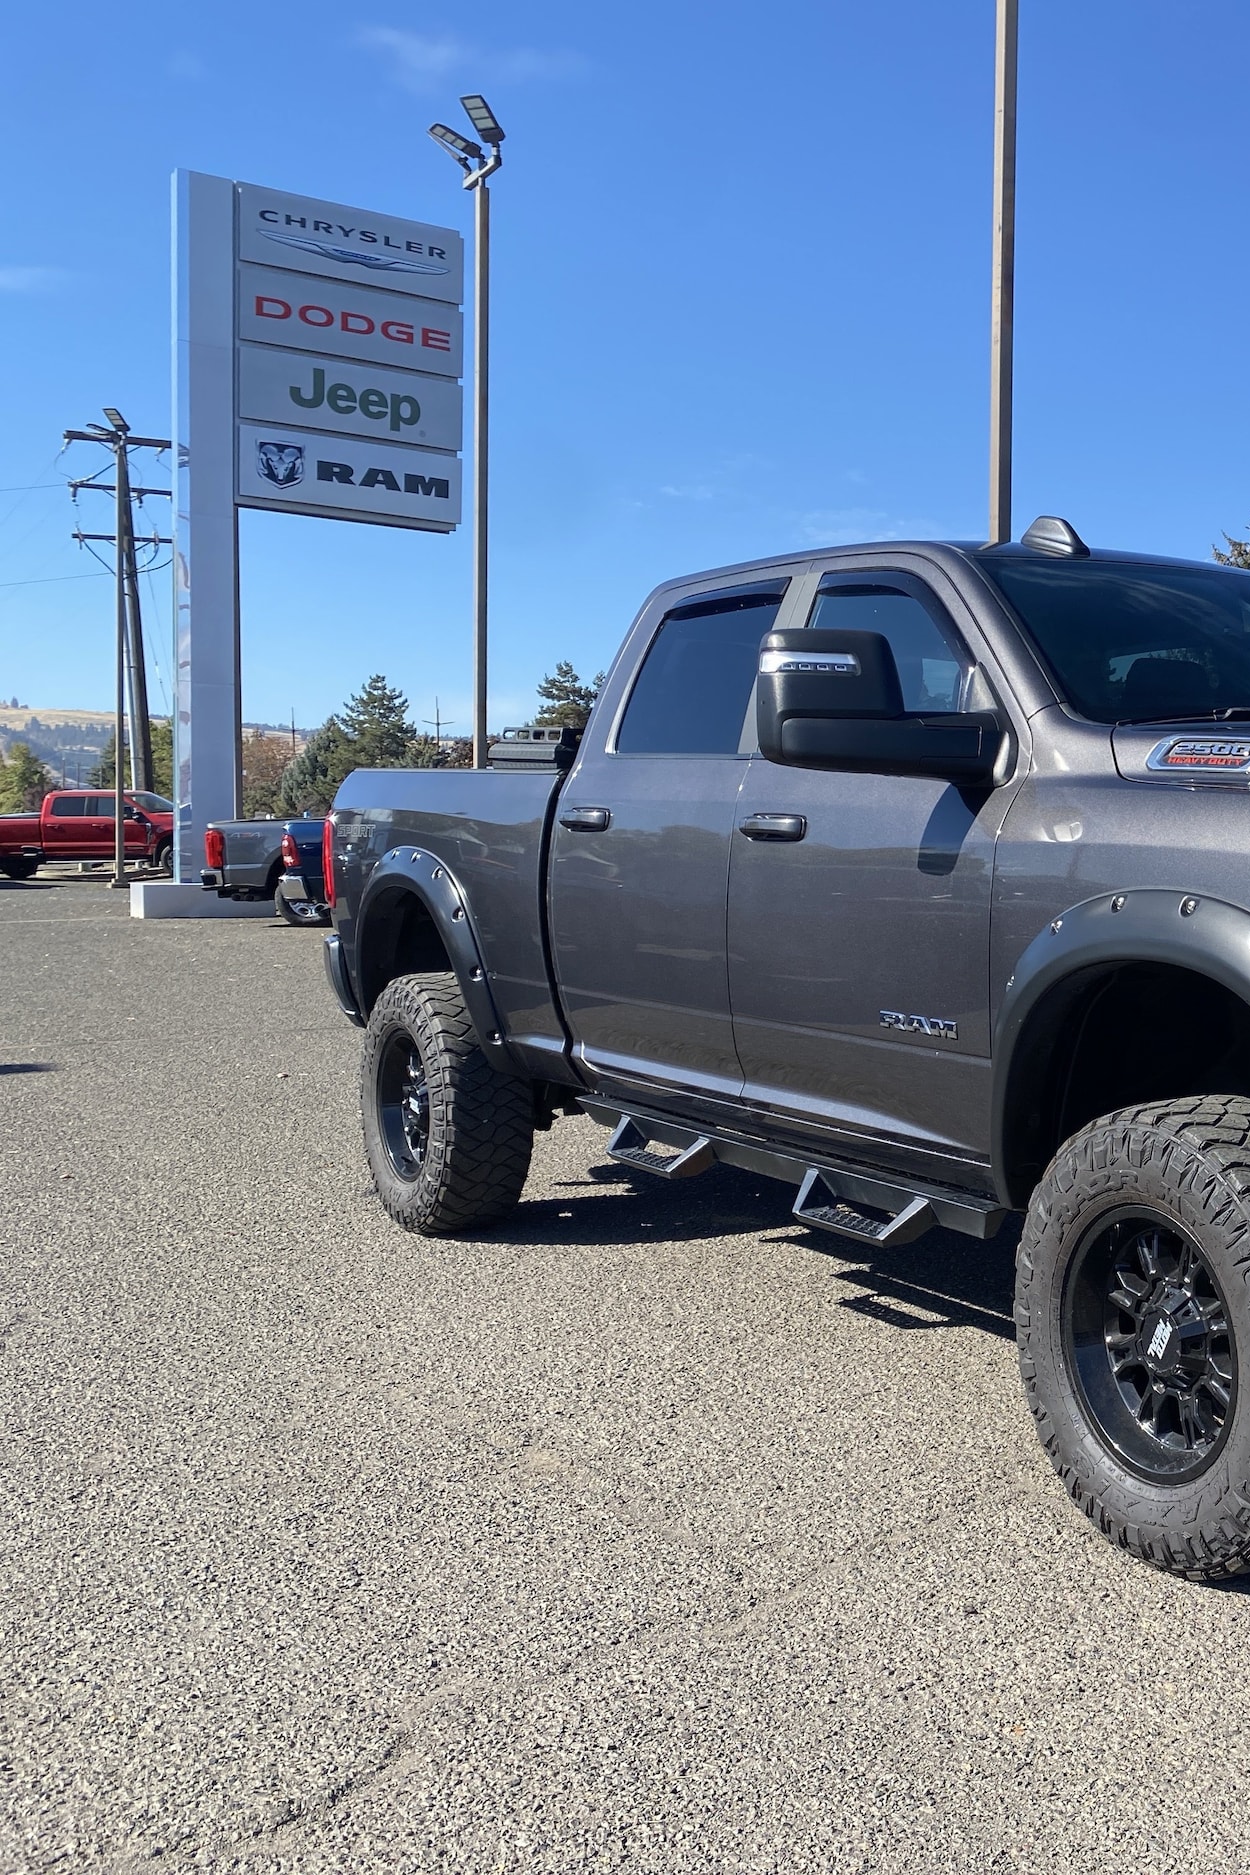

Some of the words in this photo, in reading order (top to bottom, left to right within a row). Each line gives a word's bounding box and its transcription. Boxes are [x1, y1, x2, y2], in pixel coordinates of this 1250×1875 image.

[258, 209, 447, 260] CHRYSLER
[254, 295, 451, 352] DODGE
[288, 367, 421, 432] Jeep
[316, 459, 450, 499] RAM
[1167, 756, 1208, 765] HEAVY
[1207, 757, 1244, 766] DUTY
[336, 823, 376, 838] SPORT
[879, 1009, 959, 1041] RAM
